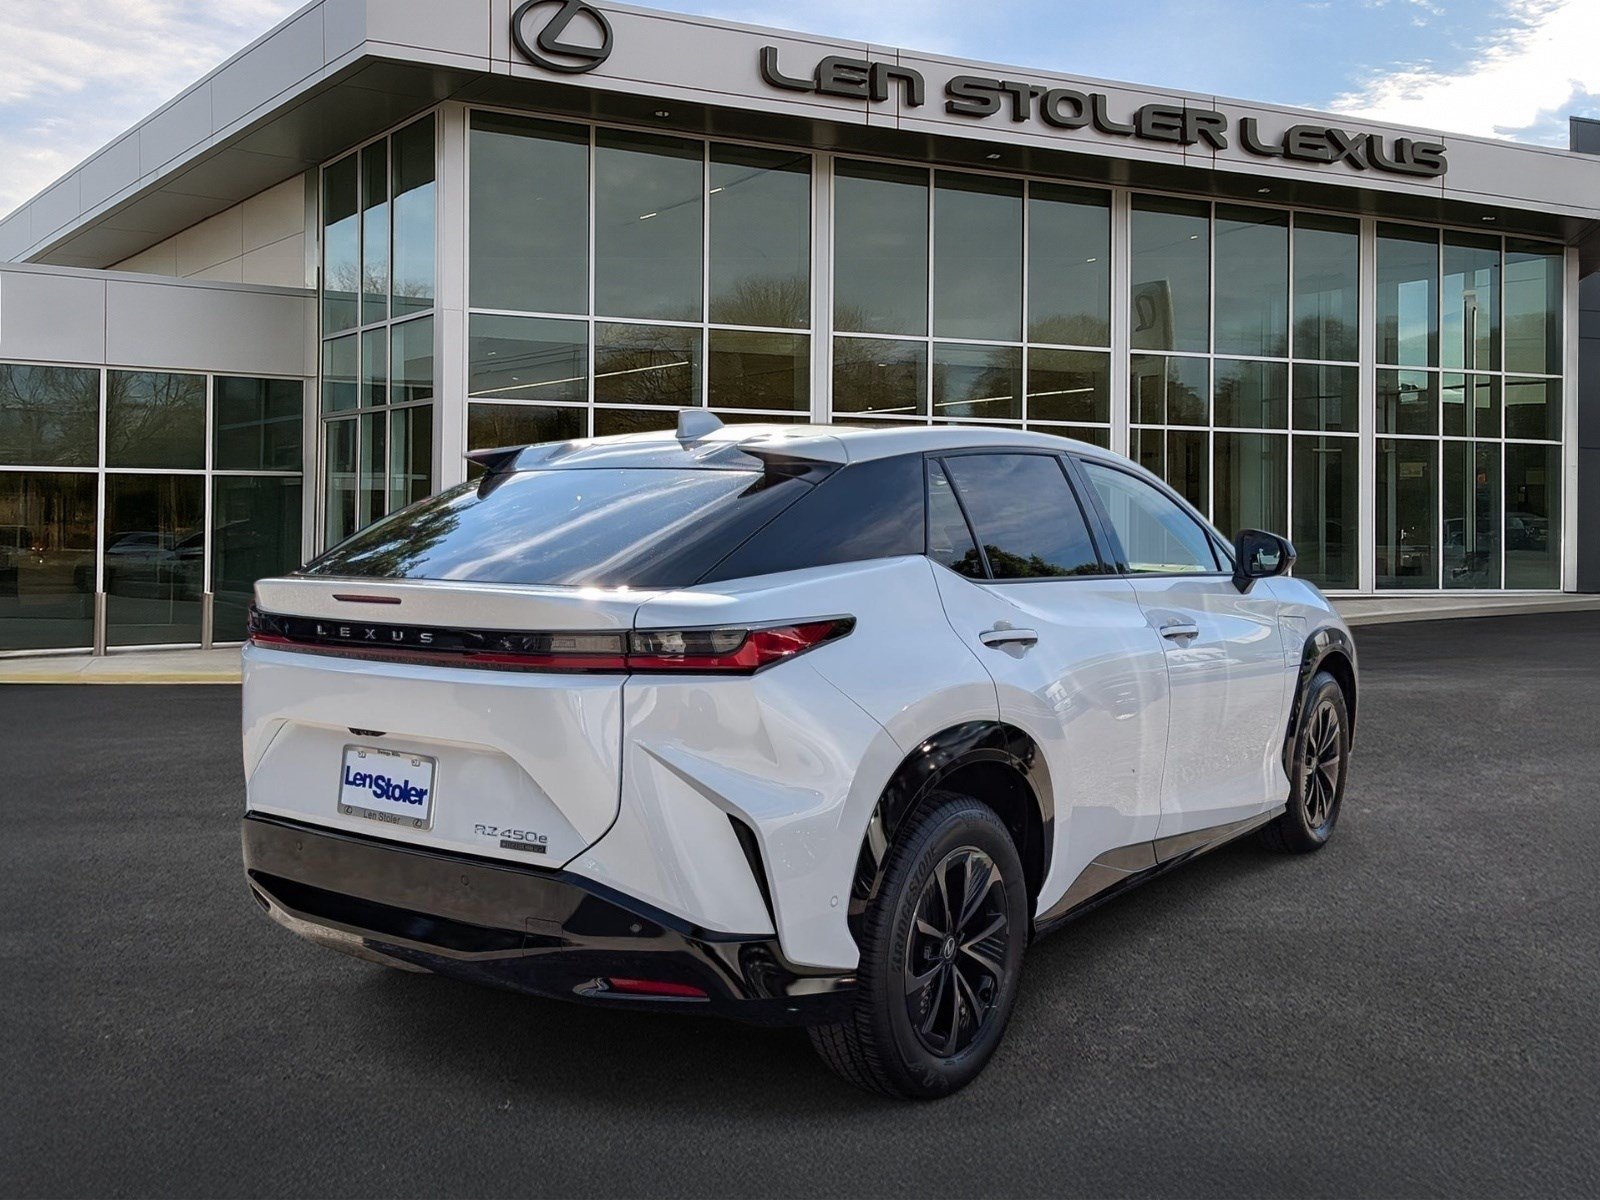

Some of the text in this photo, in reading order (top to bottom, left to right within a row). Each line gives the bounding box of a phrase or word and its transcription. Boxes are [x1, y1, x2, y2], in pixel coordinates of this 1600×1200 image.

[760, 45, 1449, 177] LEN STOLER LEXUS
[316, 624, 434, 644] LEXUS
[363, 809, 401, 825] Len Stoler
